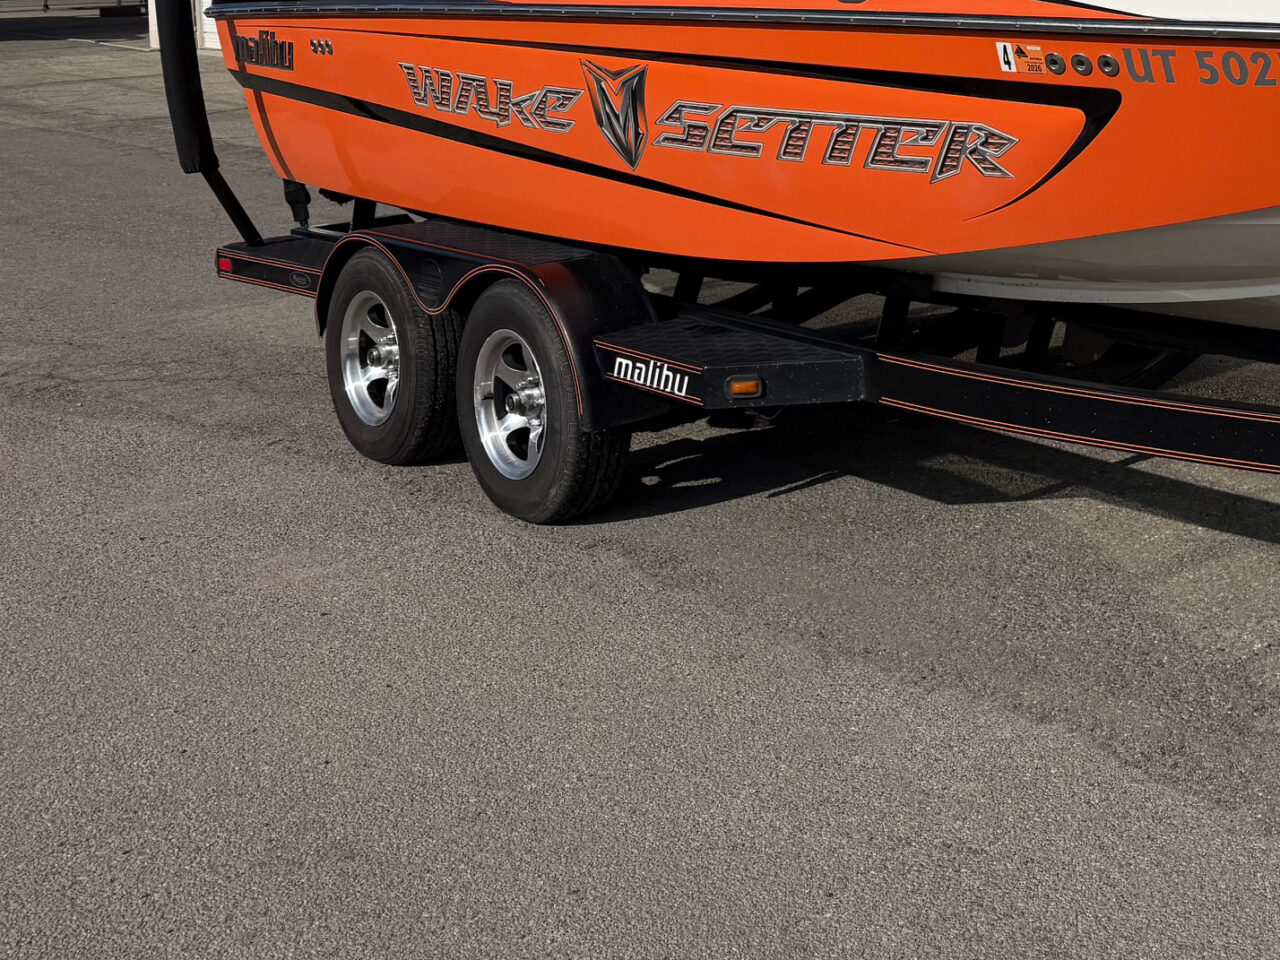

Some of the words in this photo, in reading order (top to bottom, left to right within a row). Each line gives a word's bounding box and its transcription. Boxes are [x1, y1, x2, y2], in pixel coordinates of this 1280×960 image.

[234, 29, 295, 72] malibu
[1002, 43, 1012, 71] 4
[1122, 48, 1177, 85] UT
[613, 356, 690, 397] malibu
